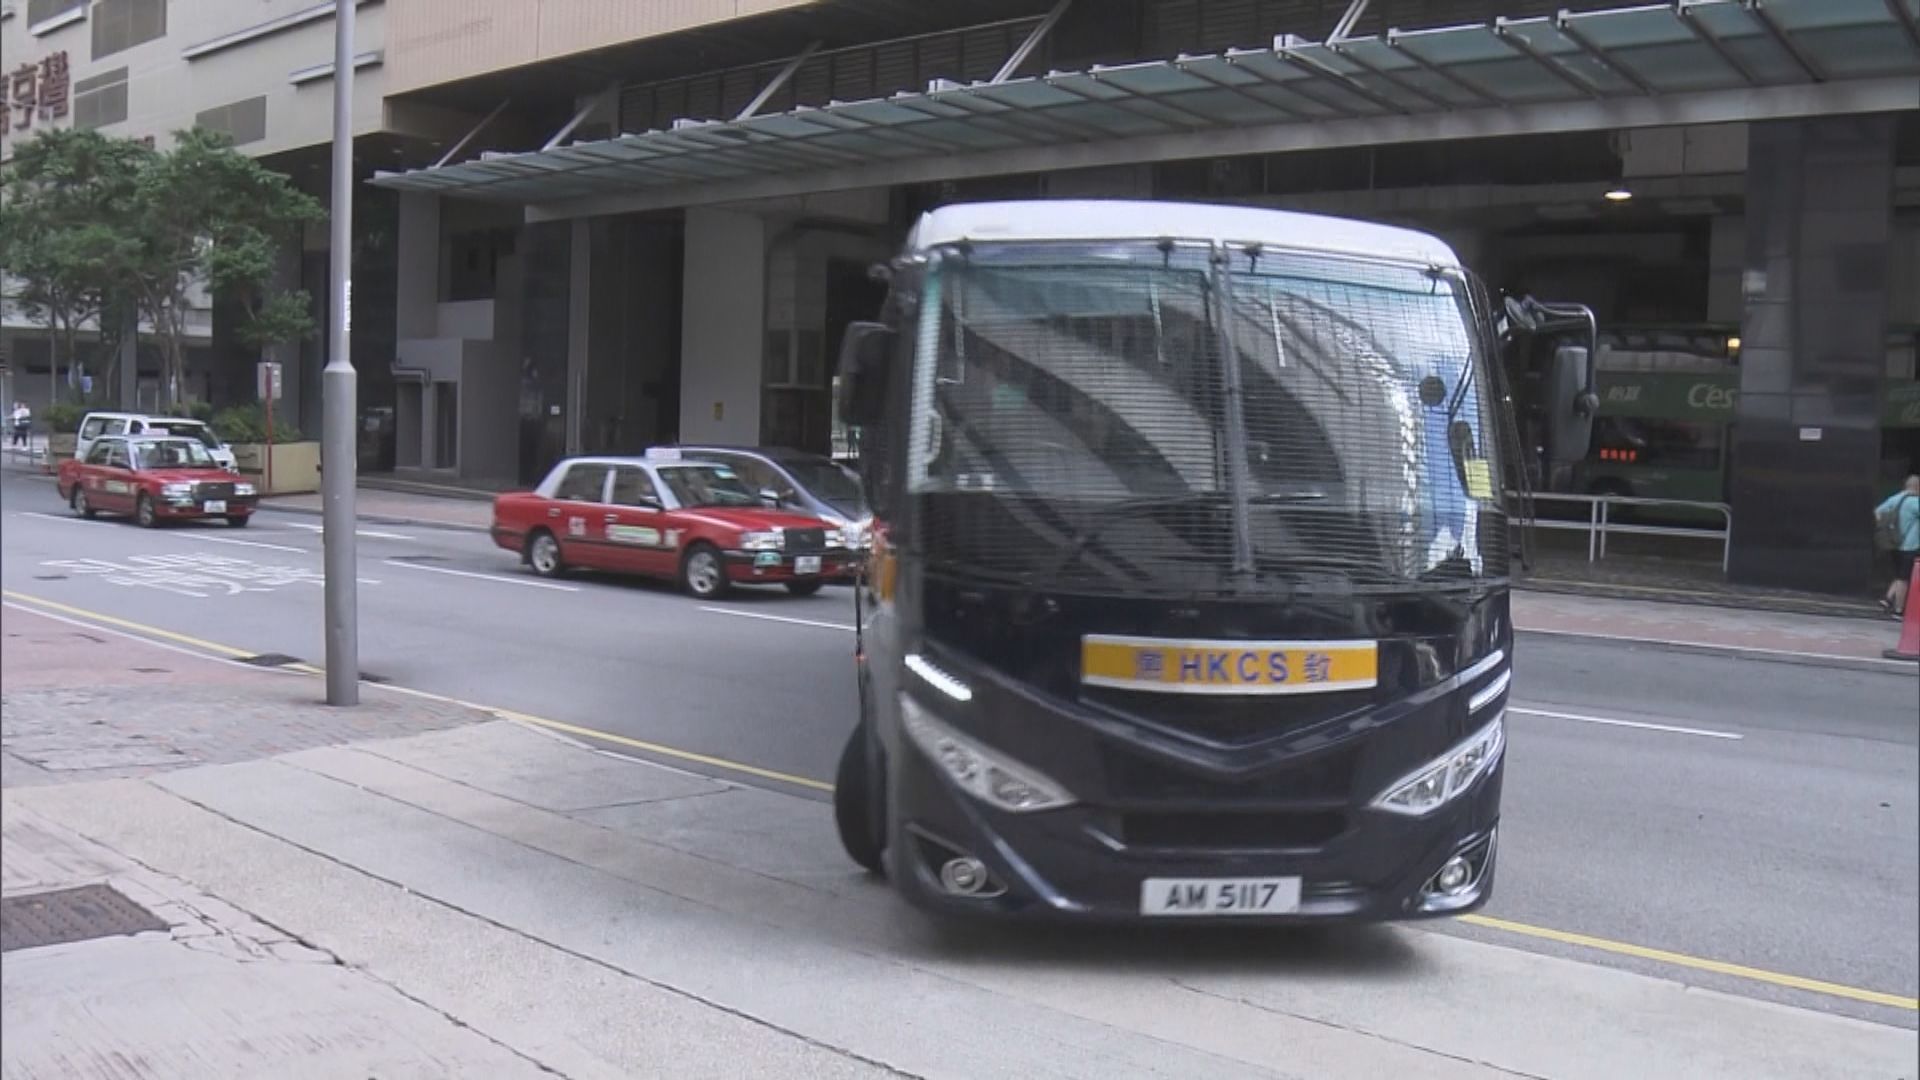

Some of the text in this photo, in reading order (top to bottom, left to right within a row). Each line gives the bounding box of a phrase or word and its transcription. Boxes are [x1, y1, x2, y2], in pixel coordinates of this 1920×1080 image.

[1180, 650, 1290, 683] HKCS
[1164, 882, 1280, 909] AM 5117
